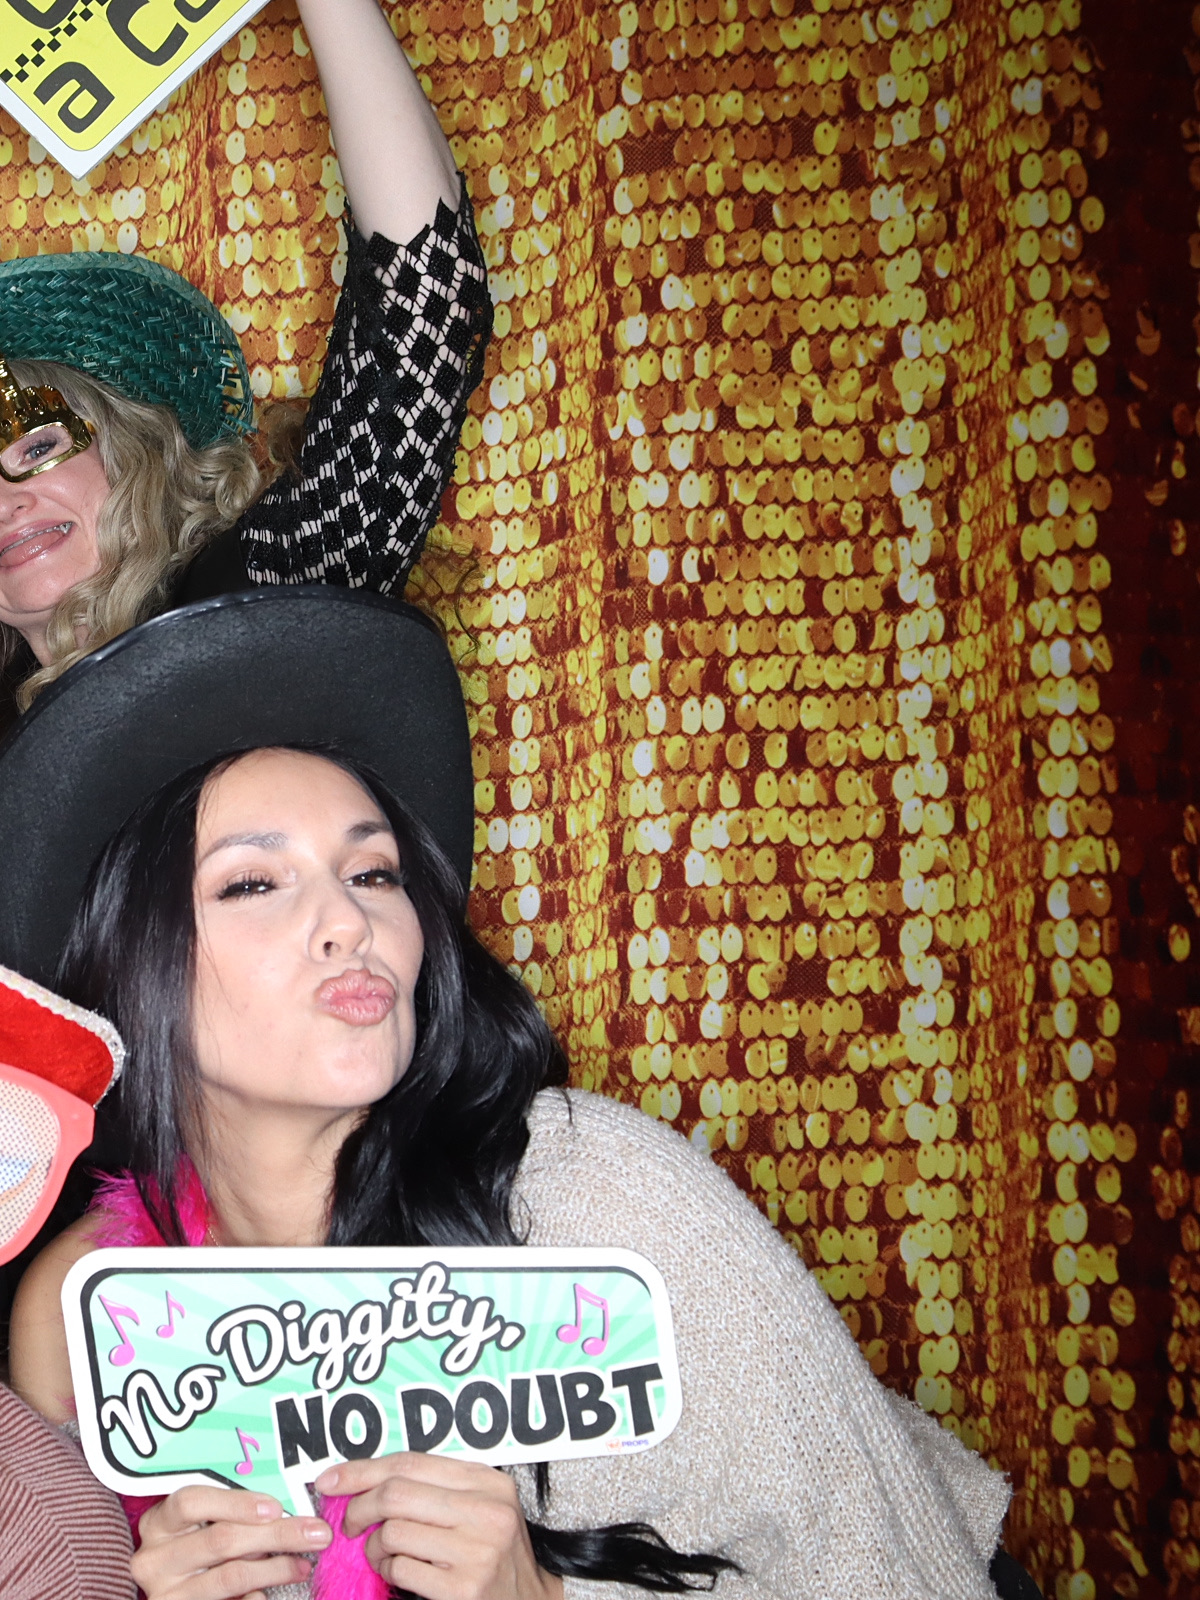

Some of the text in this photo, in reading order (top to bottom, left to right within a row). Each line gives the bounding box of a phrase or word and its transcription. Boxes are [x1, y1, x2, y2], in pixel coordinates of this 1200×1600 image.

[33, 61, 115, 134] a
[101, 1261, 526, 1459] No Diggity,
[275, 1362, 664, 1469] NO DOUBT
